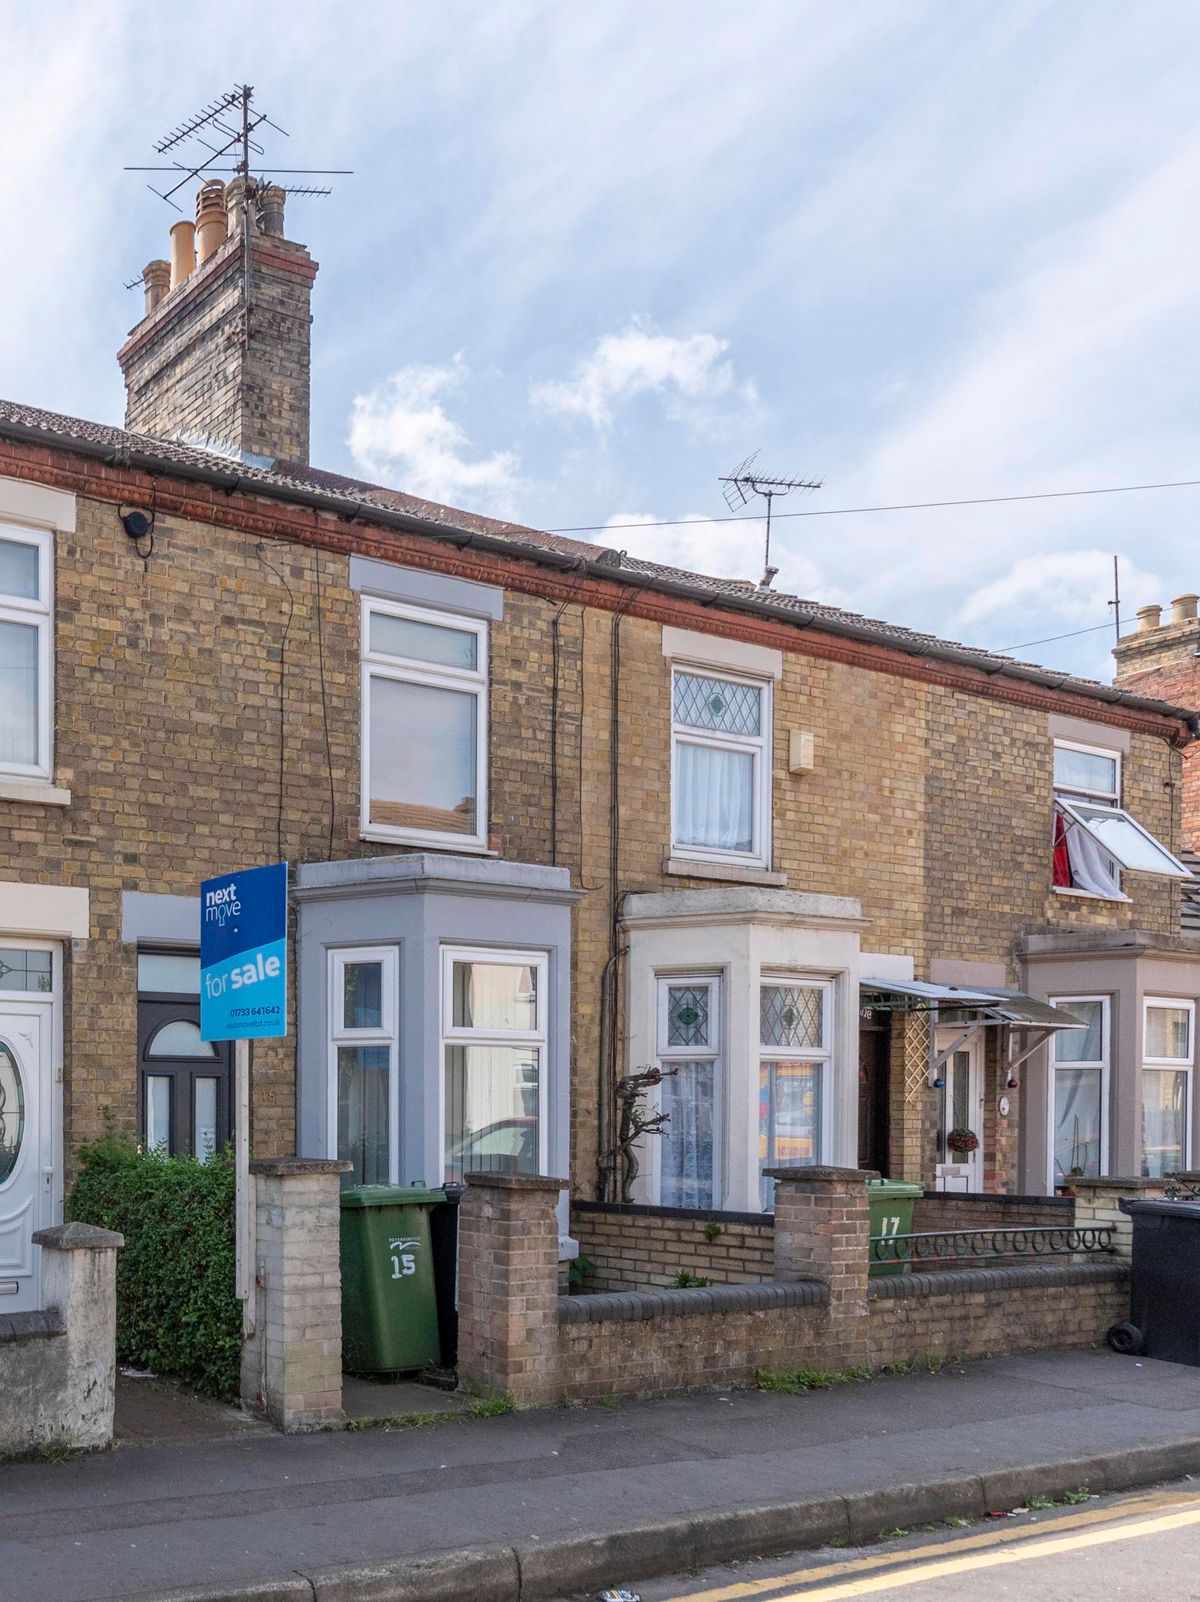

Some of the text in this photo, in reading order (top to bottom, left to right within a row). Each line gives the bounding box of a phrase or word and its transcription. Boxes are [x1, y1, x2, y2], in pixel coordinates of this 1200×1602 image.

[206, 884, 237, 906] next
[205, 901, 241, 926] move
[205, 953, 280, 999] for sale
[881, 1216, 900, 1245] 17
[391, 1254, 416, 1279] 15
